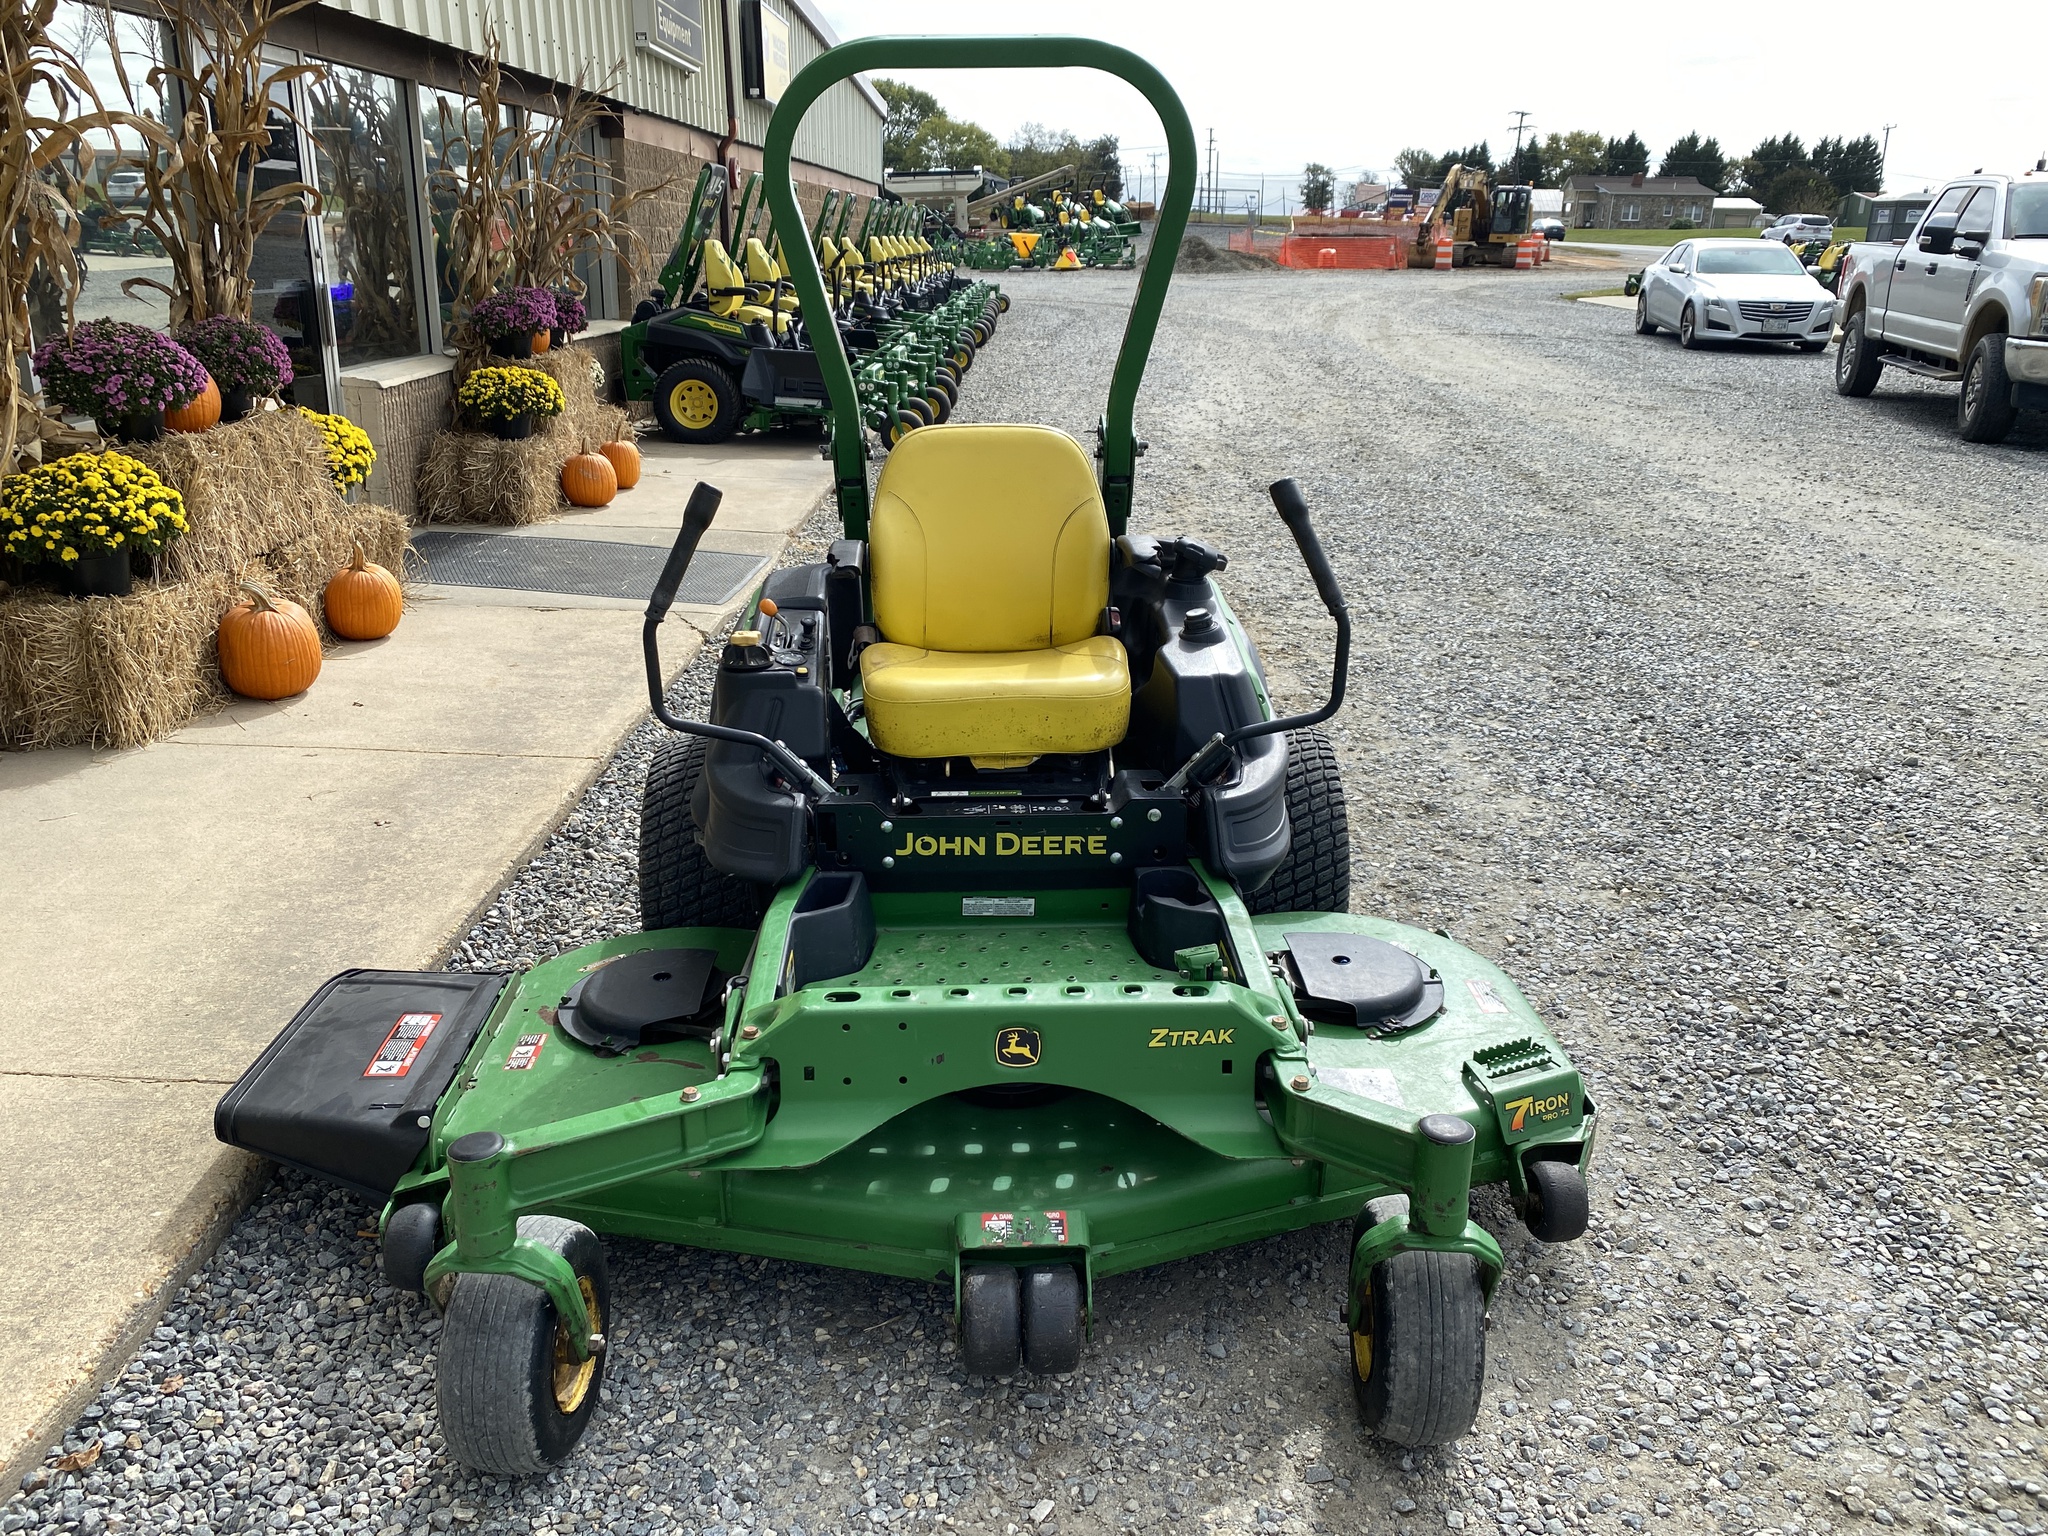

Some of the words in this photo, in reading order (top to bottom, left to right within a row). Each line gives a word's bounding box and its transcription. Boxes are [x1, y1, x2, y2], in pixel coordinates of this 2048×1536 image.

[657, 5, 692, 47] Equipment
[895, 832, 985, 856] JOHN
[996, 832, 1107, 856] DEERE
[1148, 1028, 1235, 1048] ZTRAK
[1542, 1112, 1558, 1121] PRO
[1560, 1108, 1570, 1117] 72
